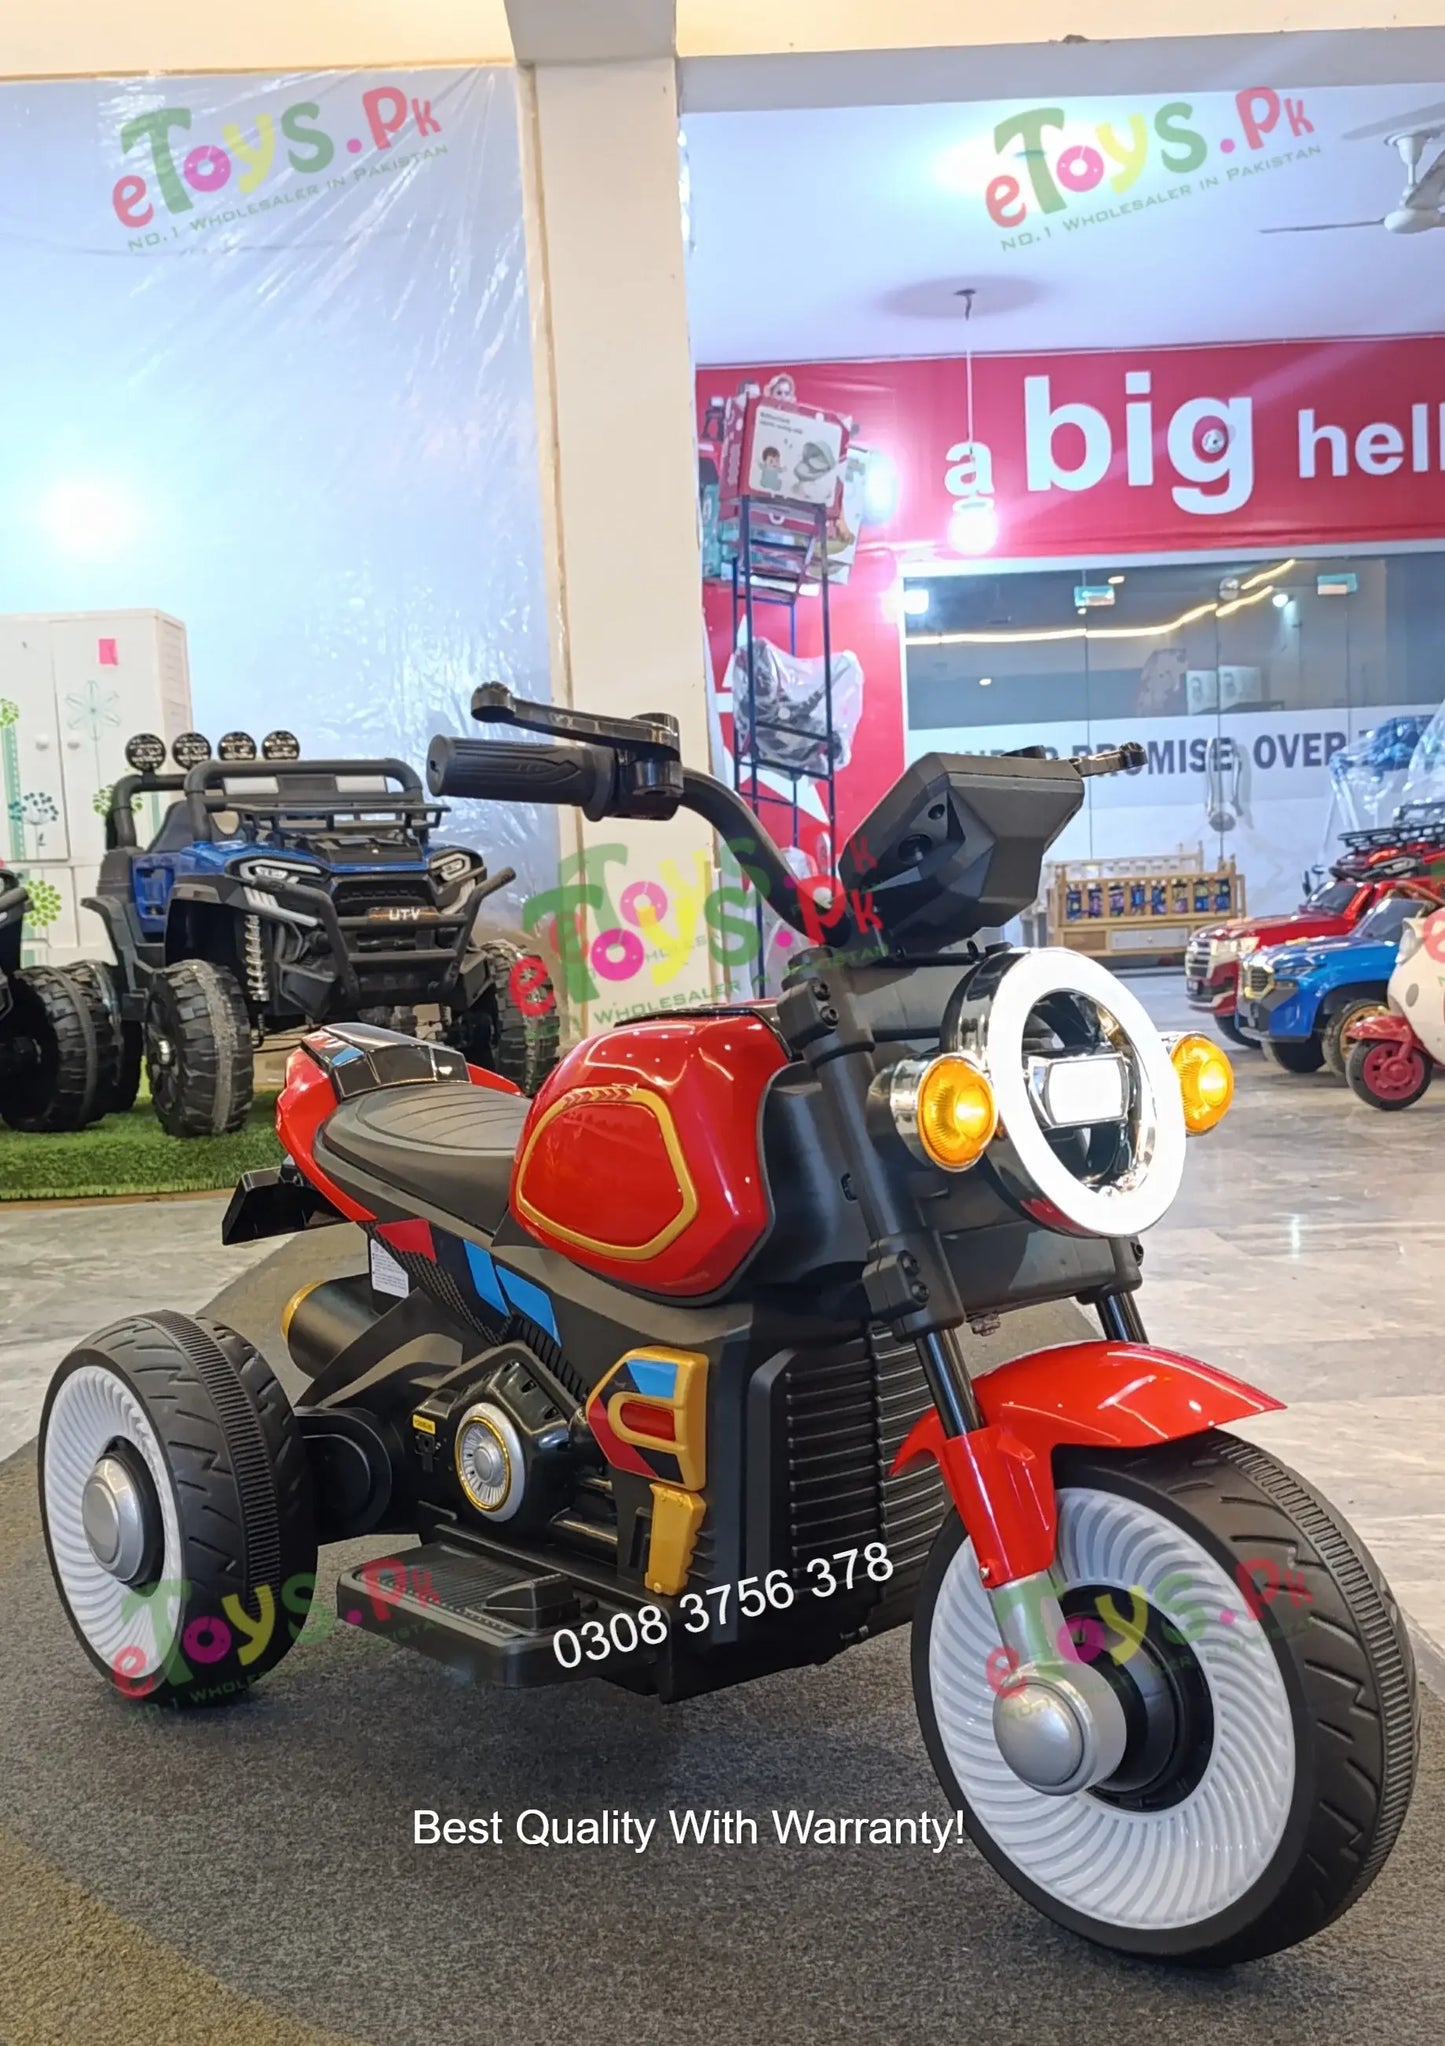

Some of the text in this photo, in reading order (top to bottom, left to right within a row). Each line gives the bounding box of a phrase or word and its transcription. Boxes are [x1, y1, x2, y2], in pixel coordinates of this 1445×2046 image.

[944, 440, 995, 497] a
[1024, 370, 1255, 515] big
[388, 907, 421, 921] UTV
